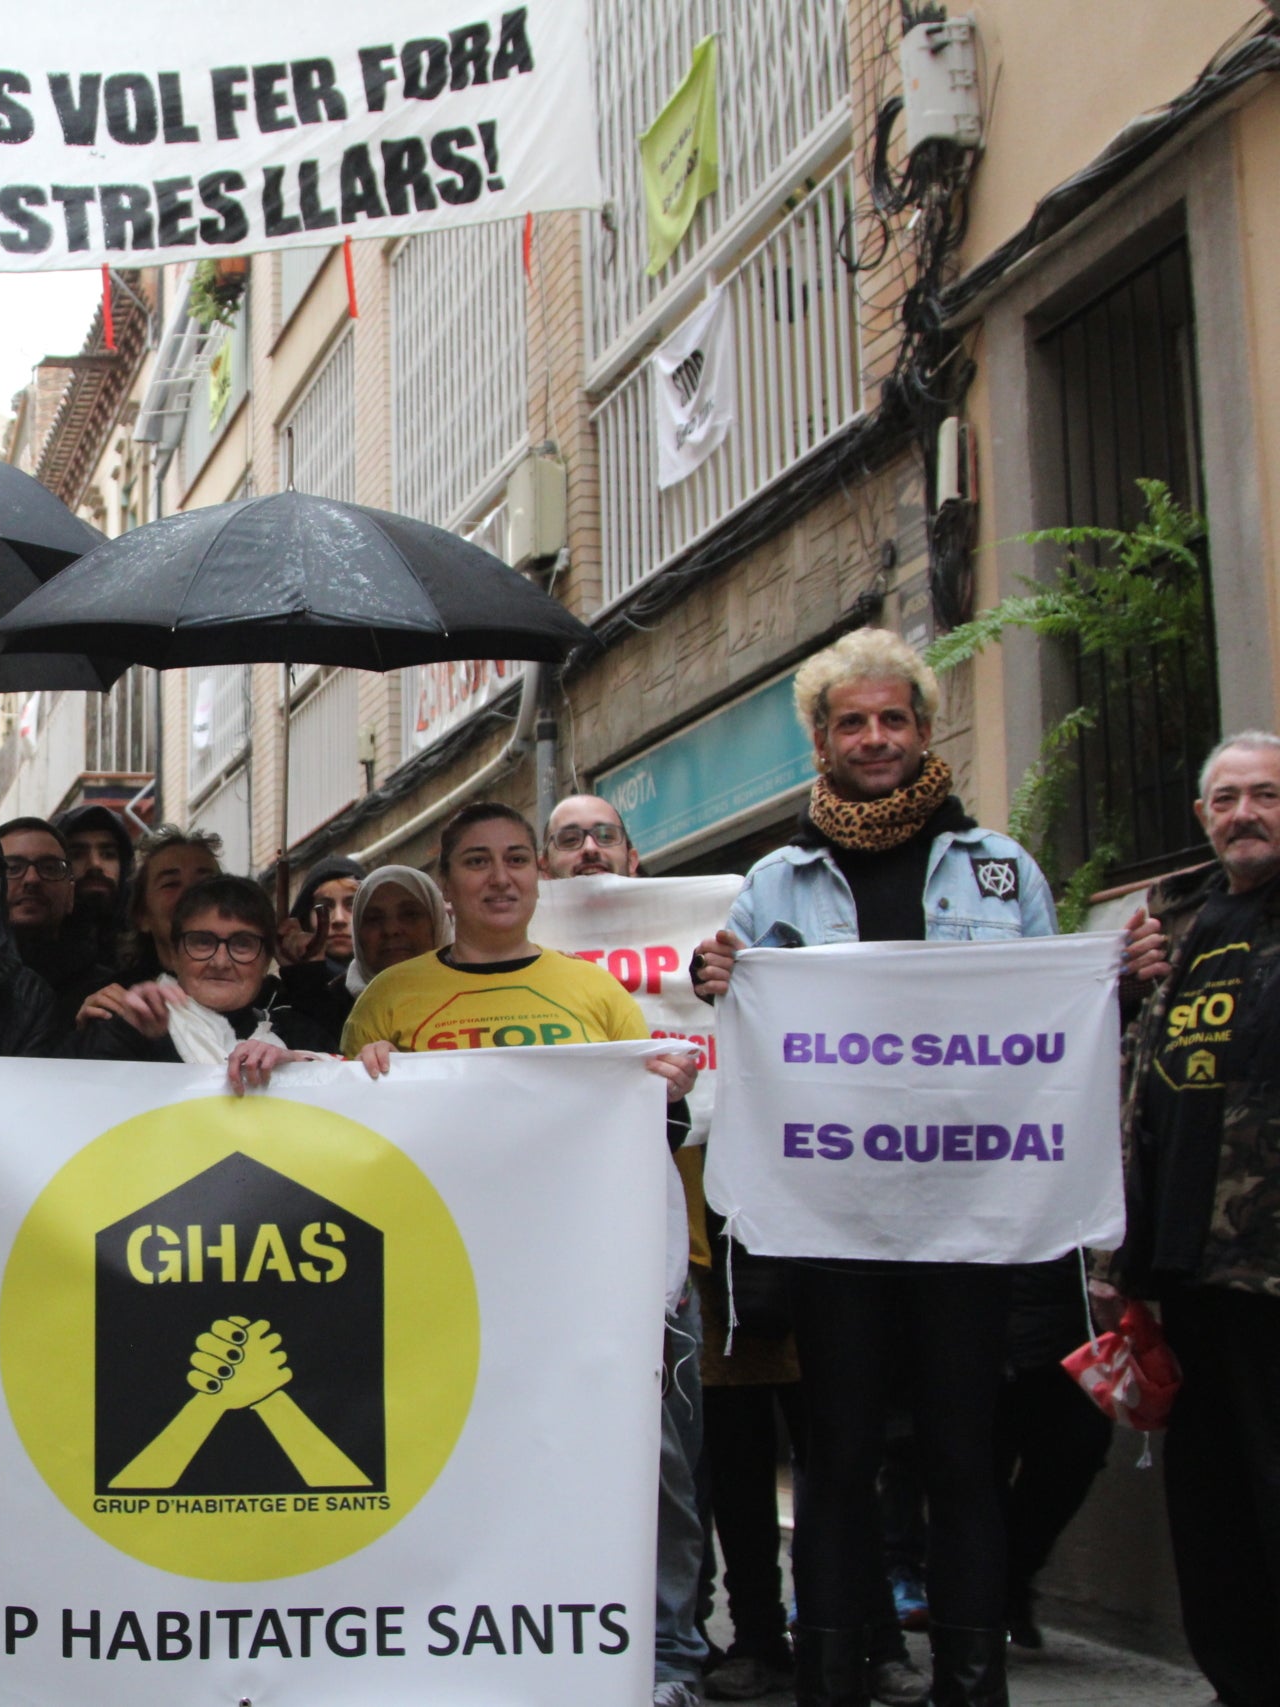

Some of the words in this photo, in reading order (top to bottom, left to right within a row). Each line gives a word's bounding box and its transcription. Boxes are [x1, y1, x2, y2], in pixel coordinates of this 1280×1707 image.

[48, 73, 200, 146] VOL
[211, 58, 347, 141] FER
[358, 8, 534, 112] FORA
[261, 120, 505, 239] LLARS!
[782, 1032, 904, 1066] BLOC
[911, 1032, 1065, 1066] SALOU
[783, 1123, 854, 1160] ES
[862, 1123, 1064, 1162] QUEDA!
[126, 1222, 347, 1284] GHAS
[93, 1498, 150, 1514] GRUP
[156, 1497, 287, 1514] D'HABITATGE
[293, 1497, 320, 1512] DE
[326, 1496, 391, 1511] SANTS
[61, 1606, 406, 1662] HABITATGE
[427, 1602, 630, 1657] SANTS
